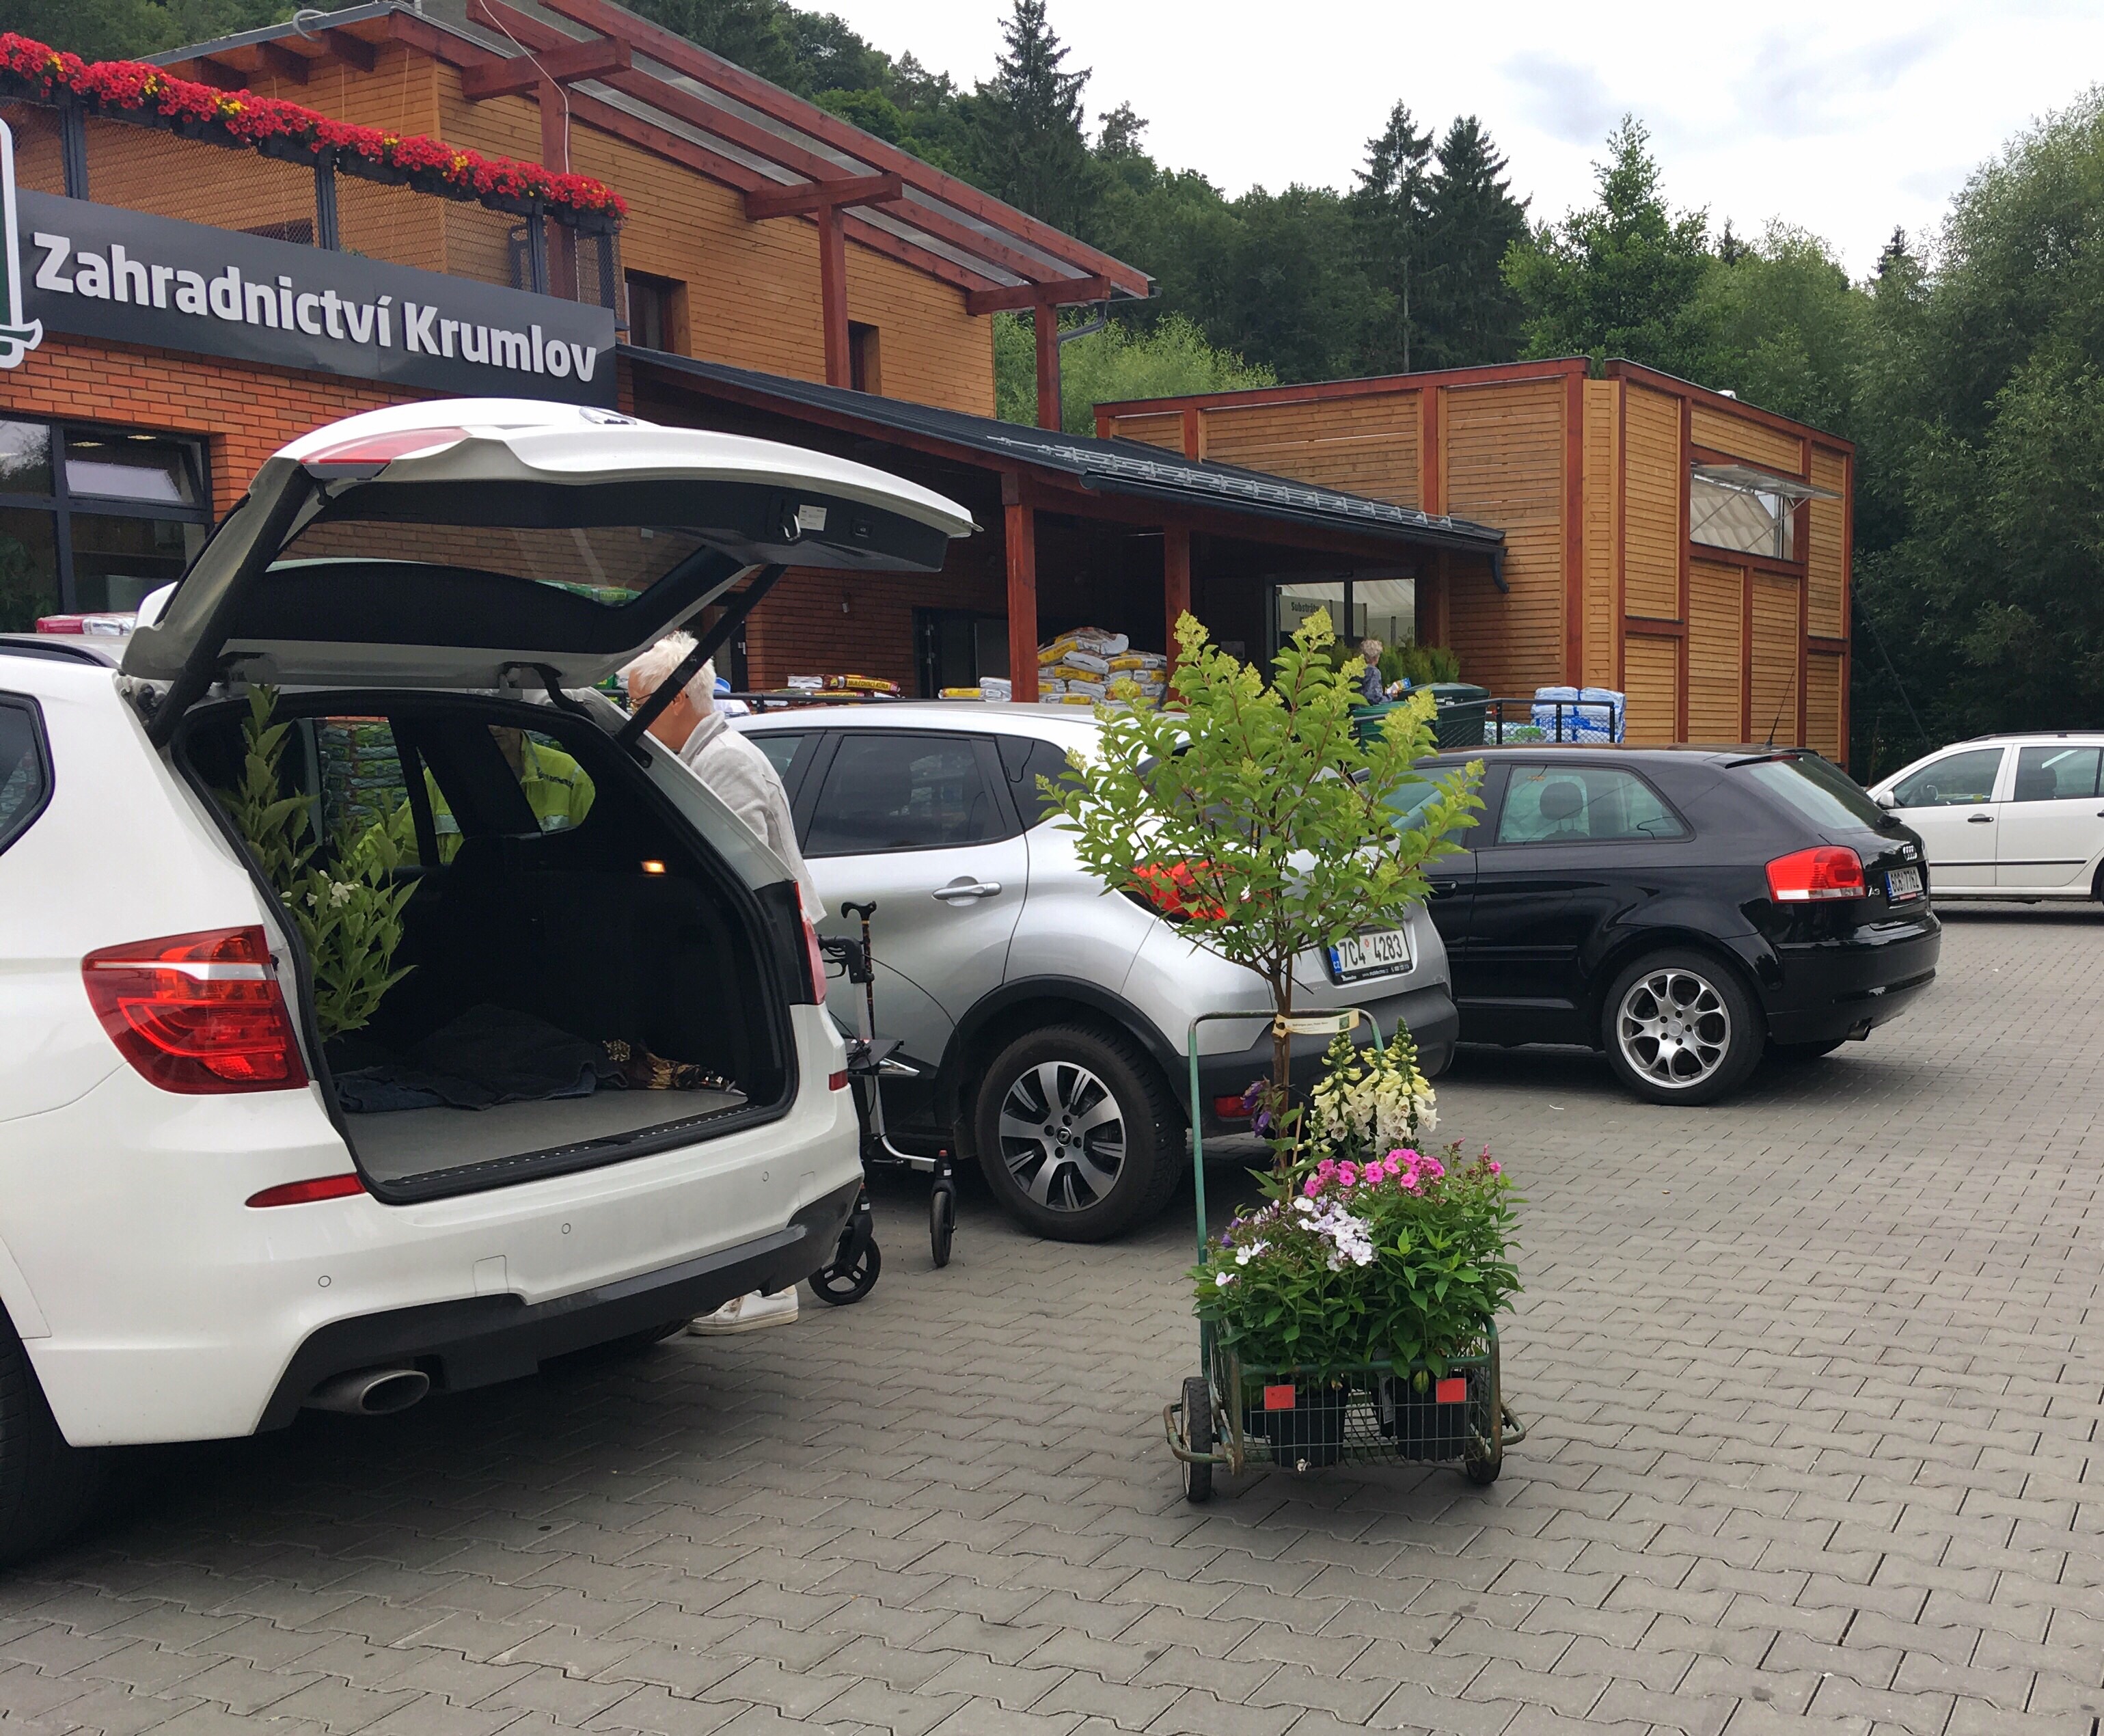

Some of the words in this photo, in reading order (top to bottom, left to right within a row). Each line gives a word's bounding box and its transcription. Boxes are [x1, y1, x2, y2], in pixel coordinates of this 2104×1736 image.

[33, 231, 393, 348] Zahradnictví
[404, 301, 598, 383] Krumlov
[1339, 940, 1366, 968] 7C4
[1373, 934, 1403, 962] 4283
